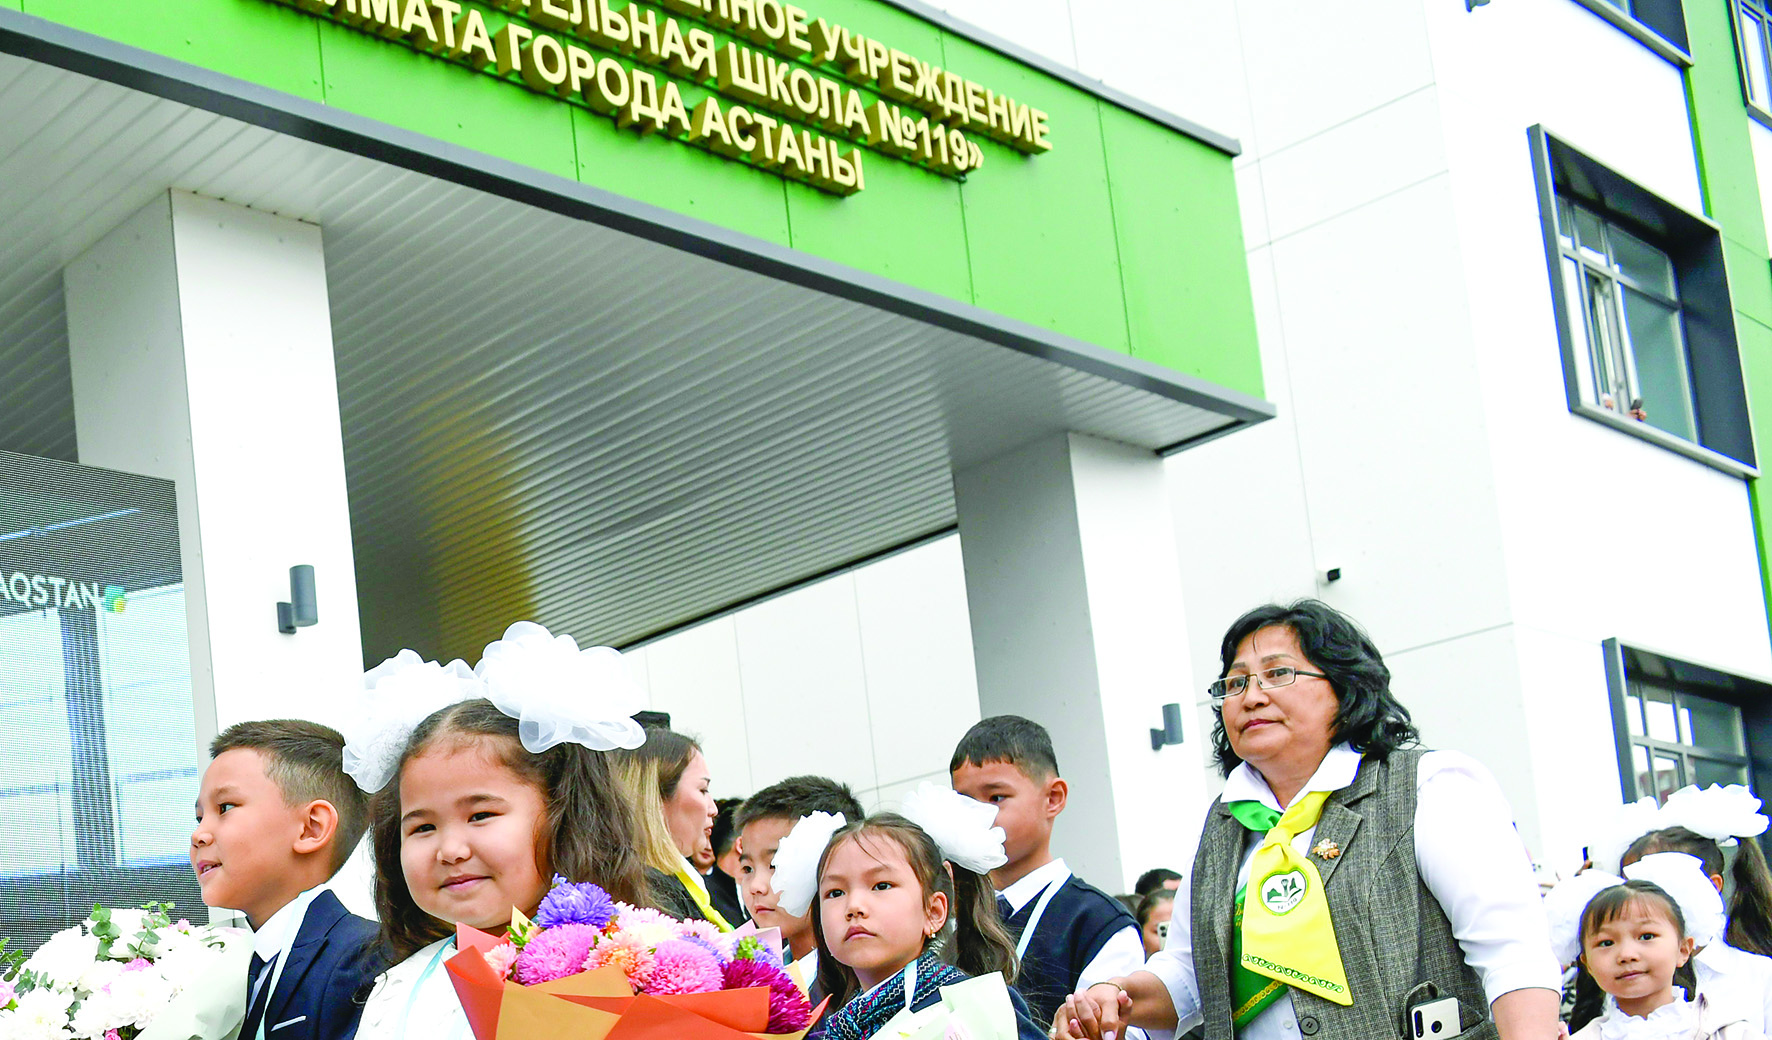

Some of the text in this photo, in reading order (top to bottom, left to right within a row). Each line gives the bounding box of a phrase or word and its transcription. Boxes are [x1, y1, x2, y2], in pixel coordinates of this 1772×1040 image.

[507, 22, 691, 131] ГОРОДА
[701, 96, 865, 190] АСТАНЫ
[680, 0, 1052, 150] НОЕ УЧРЕЖДЕНИЕ
[727, 41, 871, 136] ШКОЛА
[877, 100, 985, 171] №119»
